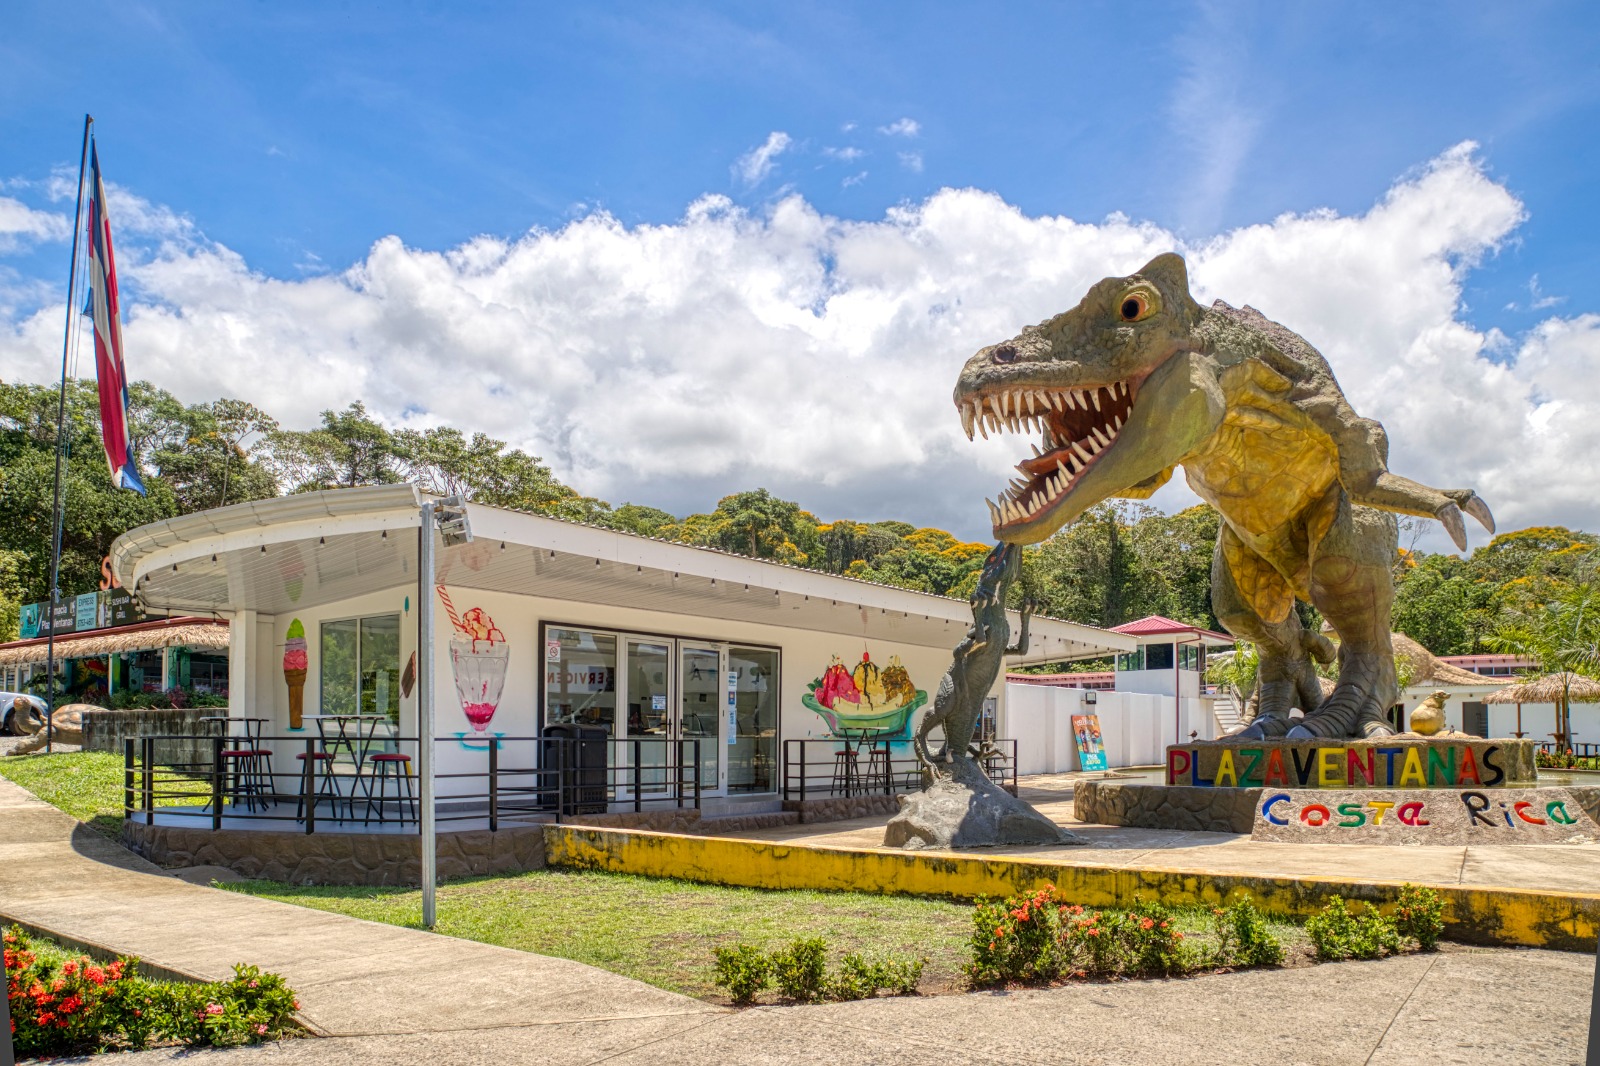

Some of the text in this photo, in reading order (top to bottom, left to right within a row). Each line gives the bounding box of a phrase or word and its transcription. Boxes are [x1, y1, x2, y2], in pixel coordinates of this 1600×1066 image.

[48, 603, 67, 615] Fmacia
[116, 611, 126, 619] GRILL
[1460, 791, 1578, 828] Rica
